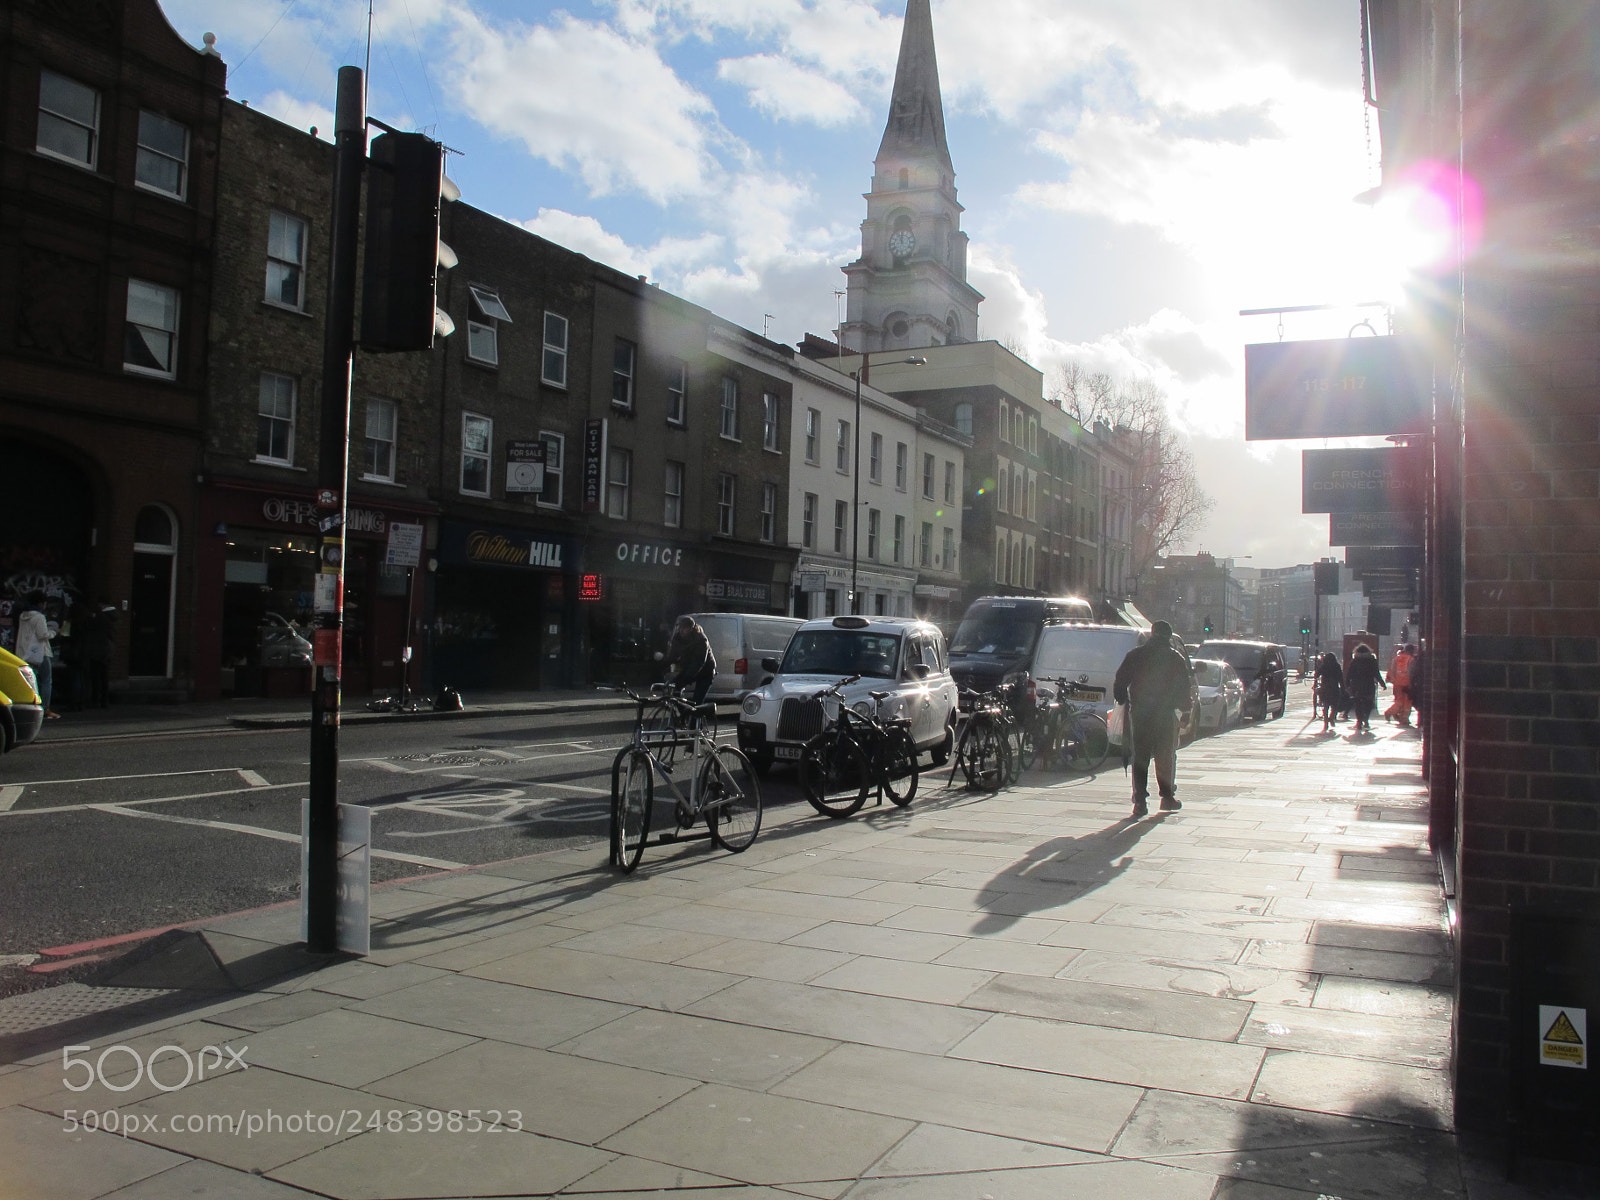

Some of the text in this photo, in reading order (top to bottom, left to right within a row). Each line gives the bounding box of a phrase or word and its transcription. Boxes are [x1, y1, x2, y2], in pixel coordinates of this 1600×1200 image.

[510, 449, 543, 457] FOR SALE
[587, 429, 599, 502] CITY MAN CARS
[1332, 470, 1393, 480] FRENCH
[1312, 480, 1414, 490] CONNECTION
[262, 497, 386, 533] OFFSRING
[466, 530, 562, 568] William HILL
[617, 542, 682, 567] OFFICE
[777, 747, 799, 758] LL66
[1548, 1045, 1578, 1053] DANGER
